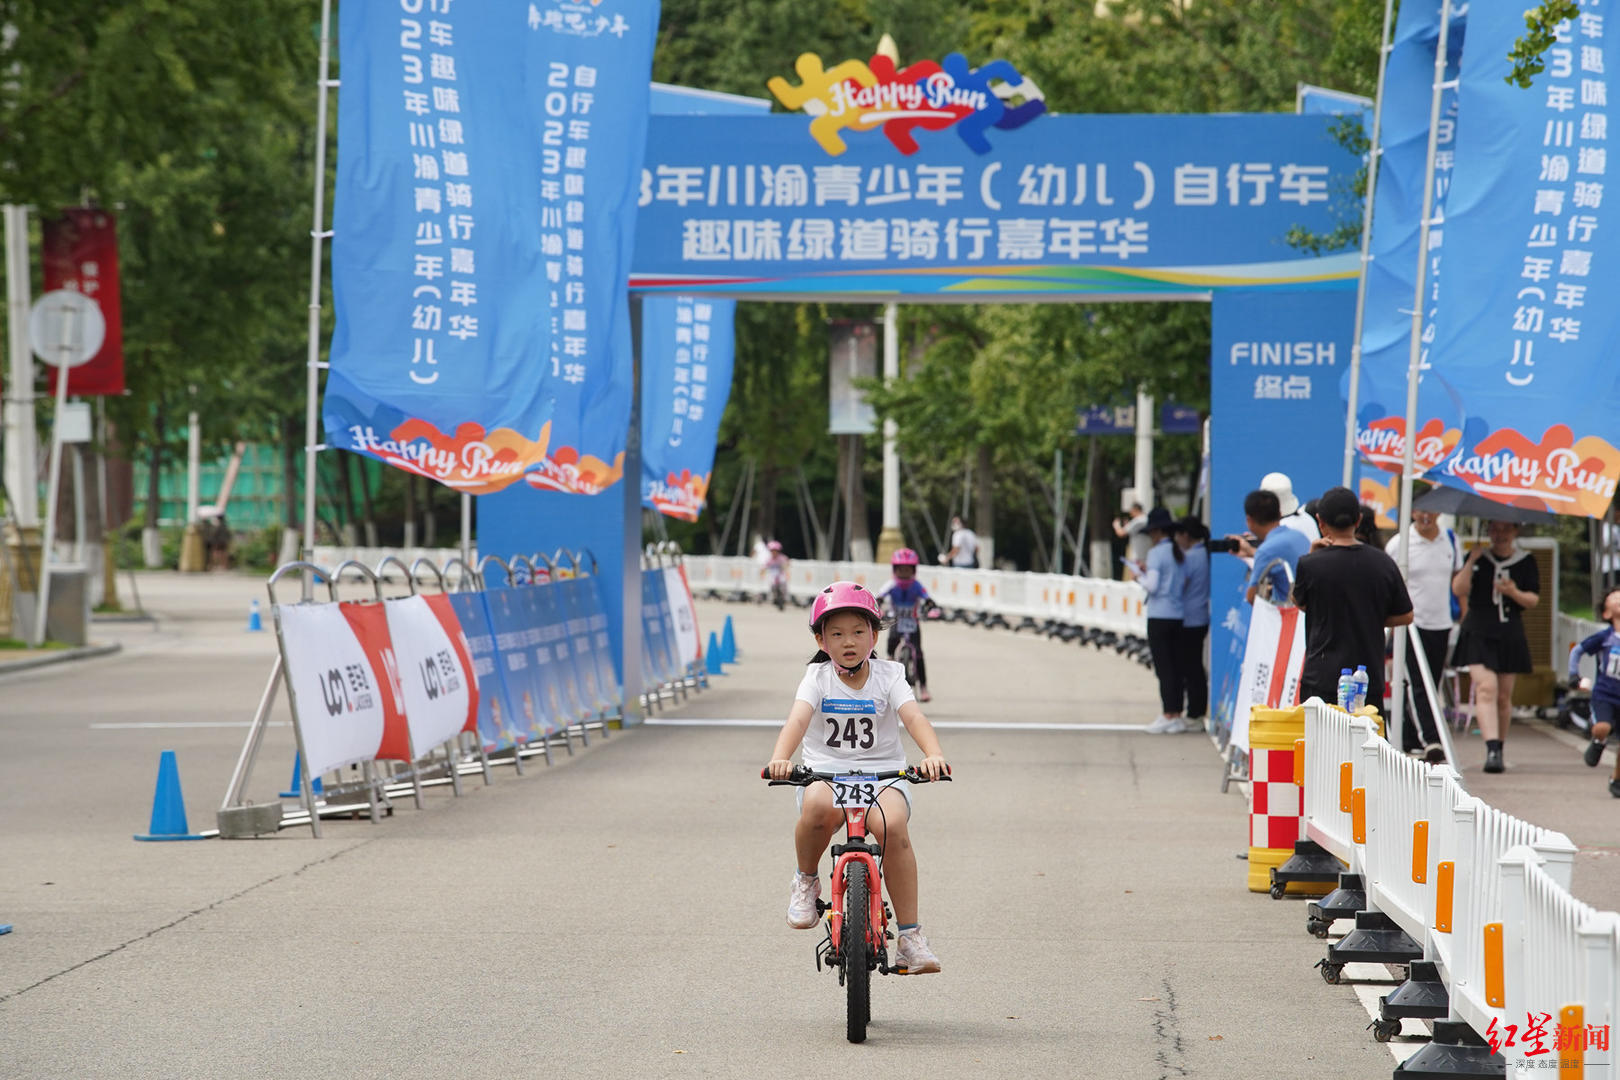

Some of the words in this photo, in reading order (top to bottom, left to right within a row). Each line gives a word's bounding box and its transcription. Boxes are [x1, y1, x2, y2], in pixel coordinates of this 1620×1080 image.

[829, 80, 923, 117] Happy
[926, 72, 989, 111] Run
[1548, 0, 1607, 343] 车趣味绿道骑行嘉年华
[682, 217, 1149, 261] 趣味绿道骑行嘉年华
[1230, 341, 1336, 366] FINISH
[1253, 374, 1312, 400] 终点
[348, 425, 458, 477] Happy
[460, 441, 524, 479] Run
[1349, 426, 1406, 456] appy
[1545, 447, 1616, 498] Run
[826, 717, 875, 750] 243
[835, 783, 876, 805] 243
